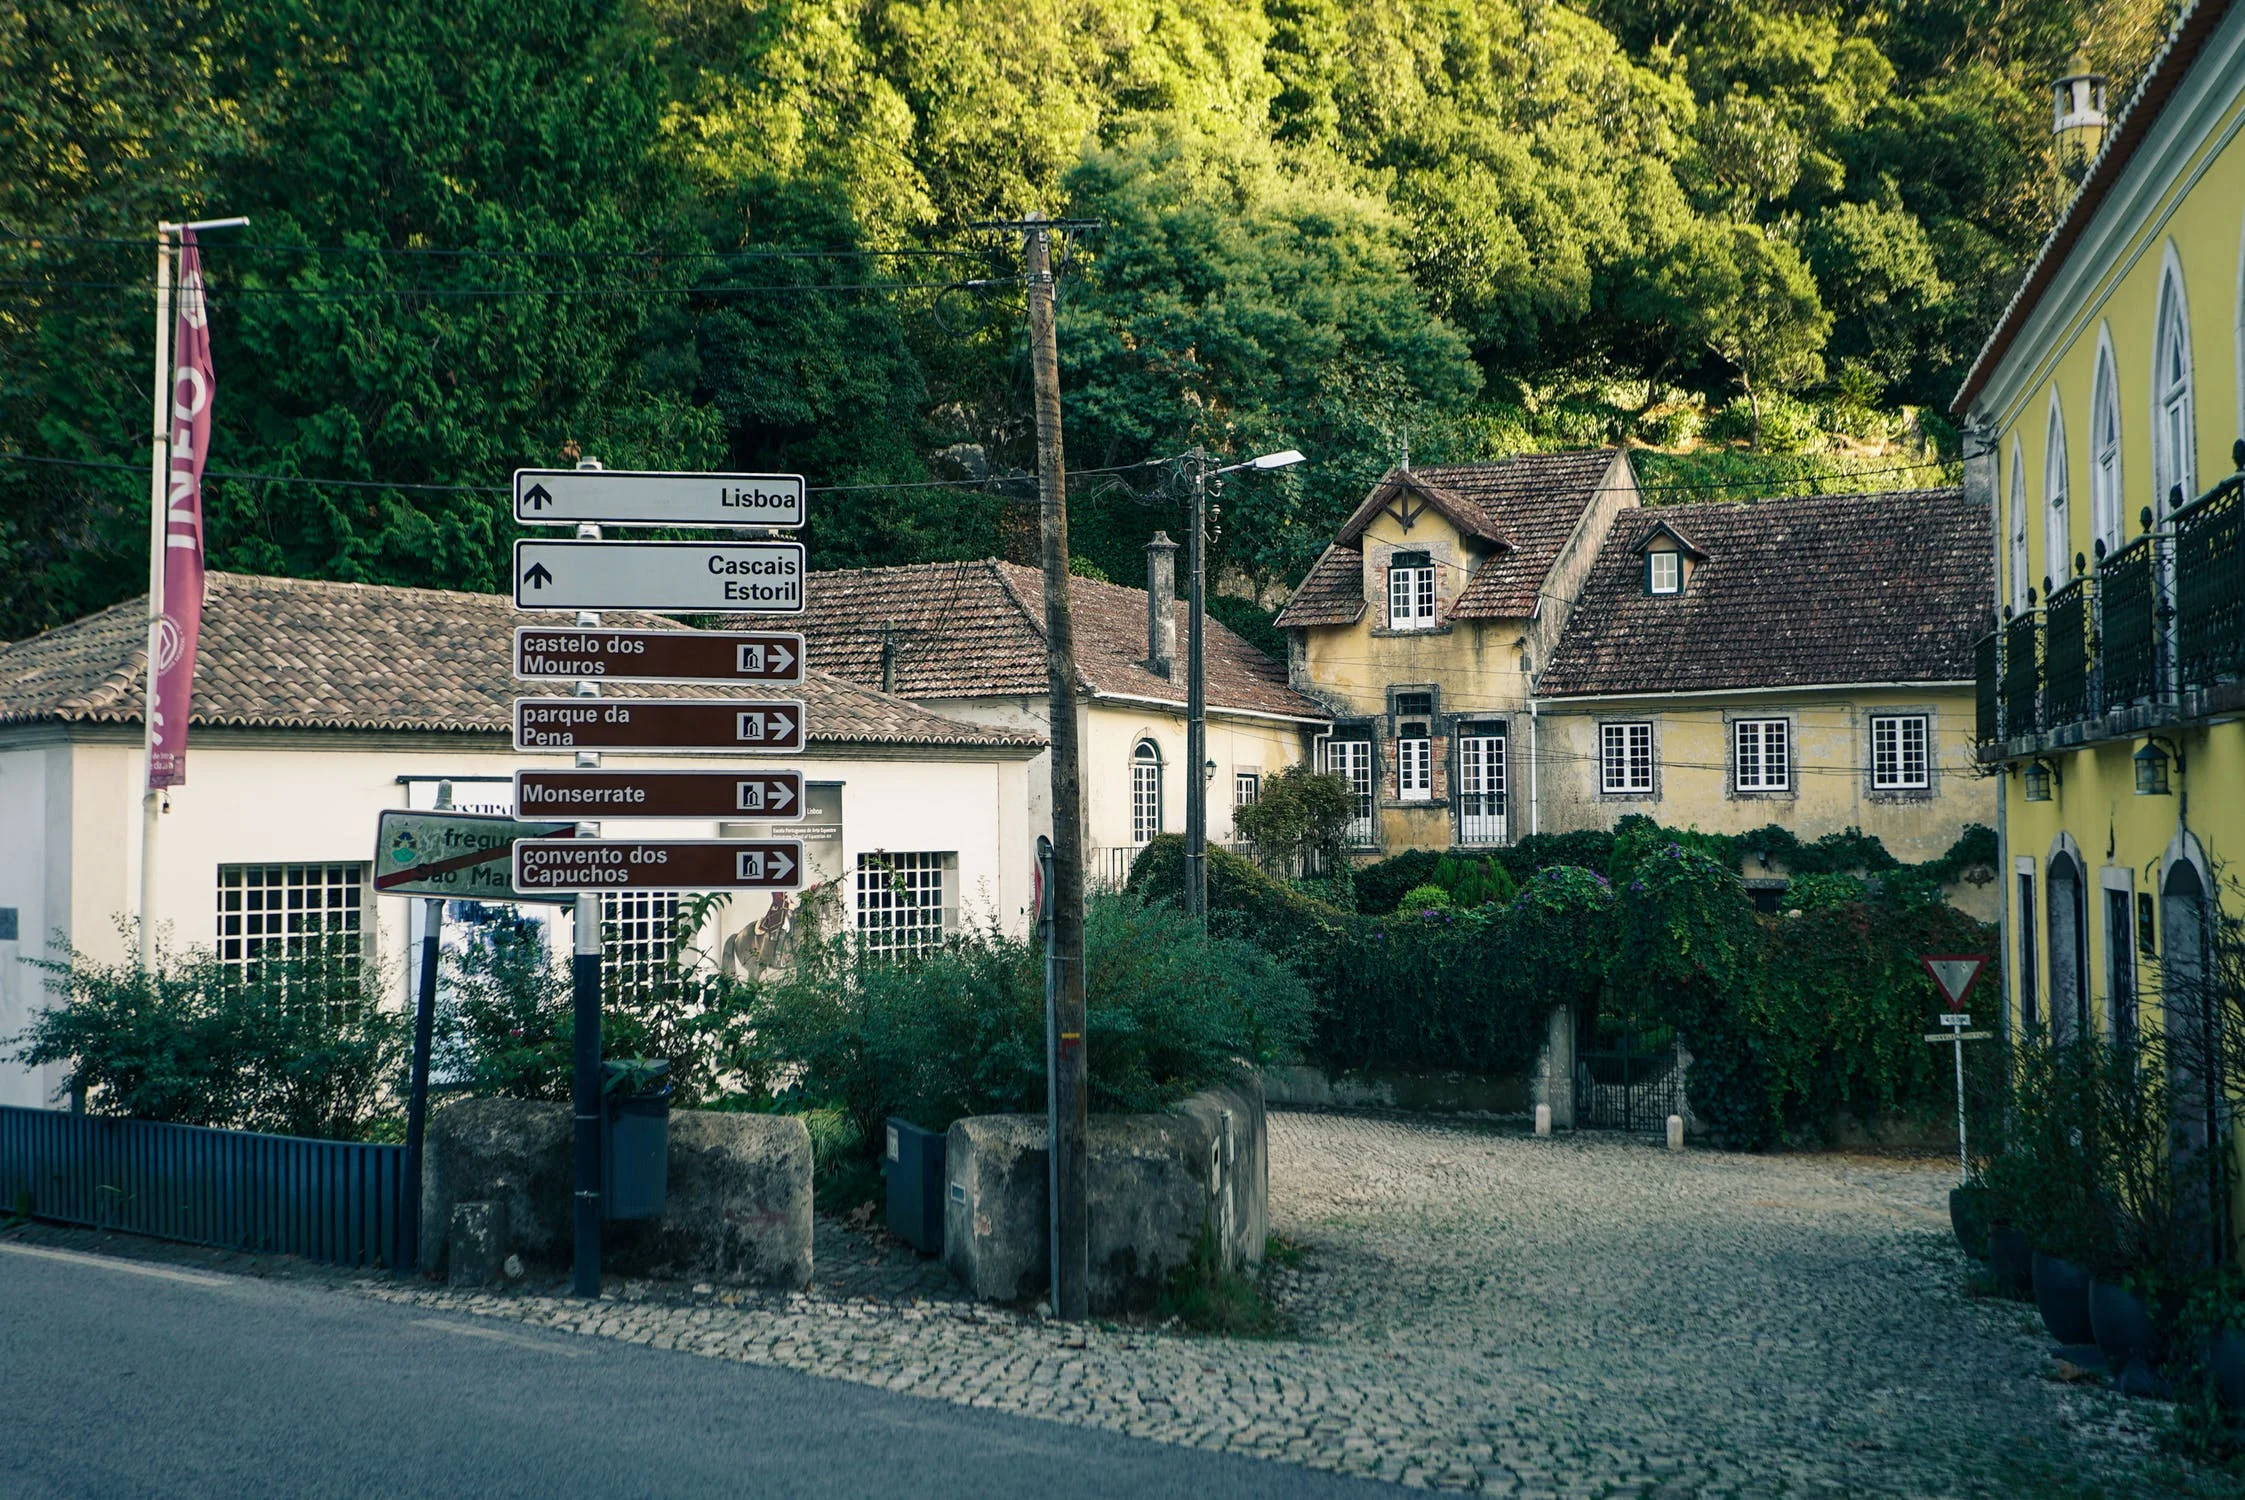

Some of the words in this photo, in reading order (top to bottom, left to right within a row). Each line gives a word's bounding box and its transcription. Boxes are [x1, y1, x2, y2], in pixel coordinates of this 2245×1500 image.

[167, 366, 207, 550] INFO
[721, 488, 796, 508] Lisboa
[708, 555, 796, 575] Cascais
[724, 581, 796, 601] Estoril
[523, 635, 600, 653] castelo
[606, 636, 645, 654] dos
[523, 655, 606, 674] Mouros
[523, 706, 598, 727] parque
[604, 705, 630, 723] da
[523, 728, 574, 746] Pena
[523, 784, 646, 803] Monserrate
[806, 807, 823, 815] Lisboa
[523, 848, 620, 864] convento
[629, 846, 667, 864] dos
[523, 865, 629, 887] Capuchos
